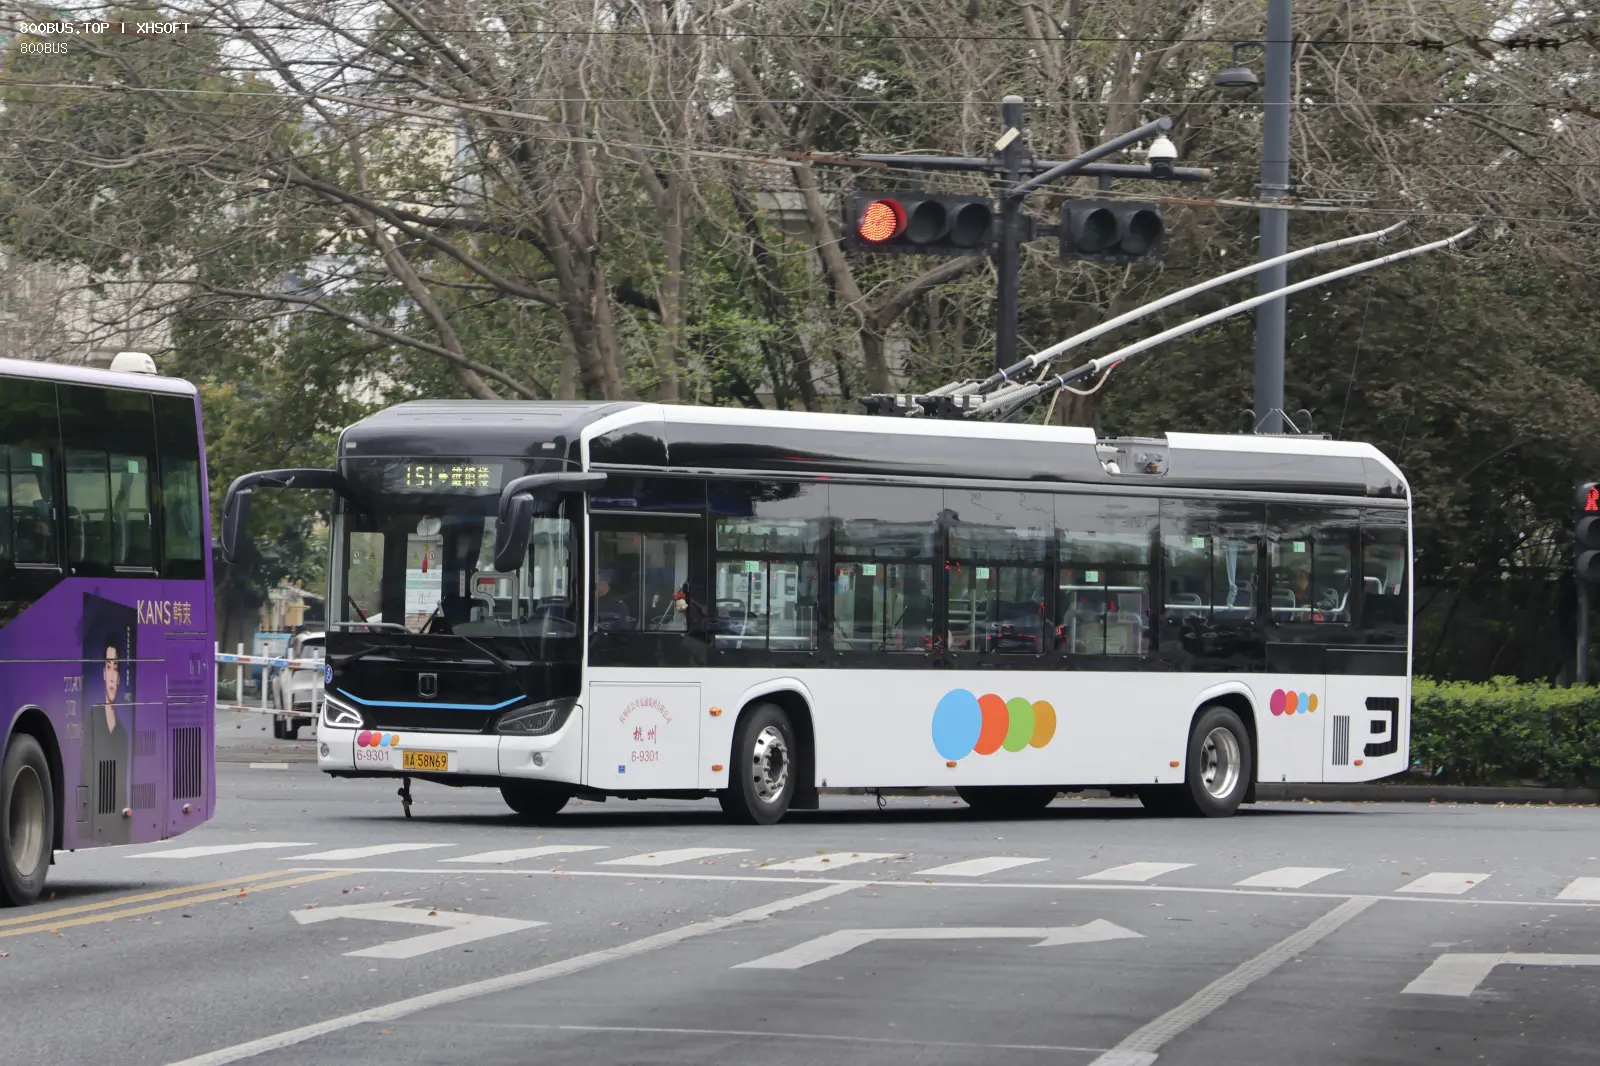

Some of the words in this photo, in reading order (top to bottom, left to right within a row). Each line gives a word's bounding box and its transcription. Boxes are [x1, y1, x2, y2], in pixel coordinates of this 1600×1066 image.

[137, 599, 171, 625] KANS
[173, 601, 192, 625] 韩束
[632, 724, 657, 745] 杭州
[356, 749, 389, 762] 6-9301
[631, 749, 659, 763] 6-9301
